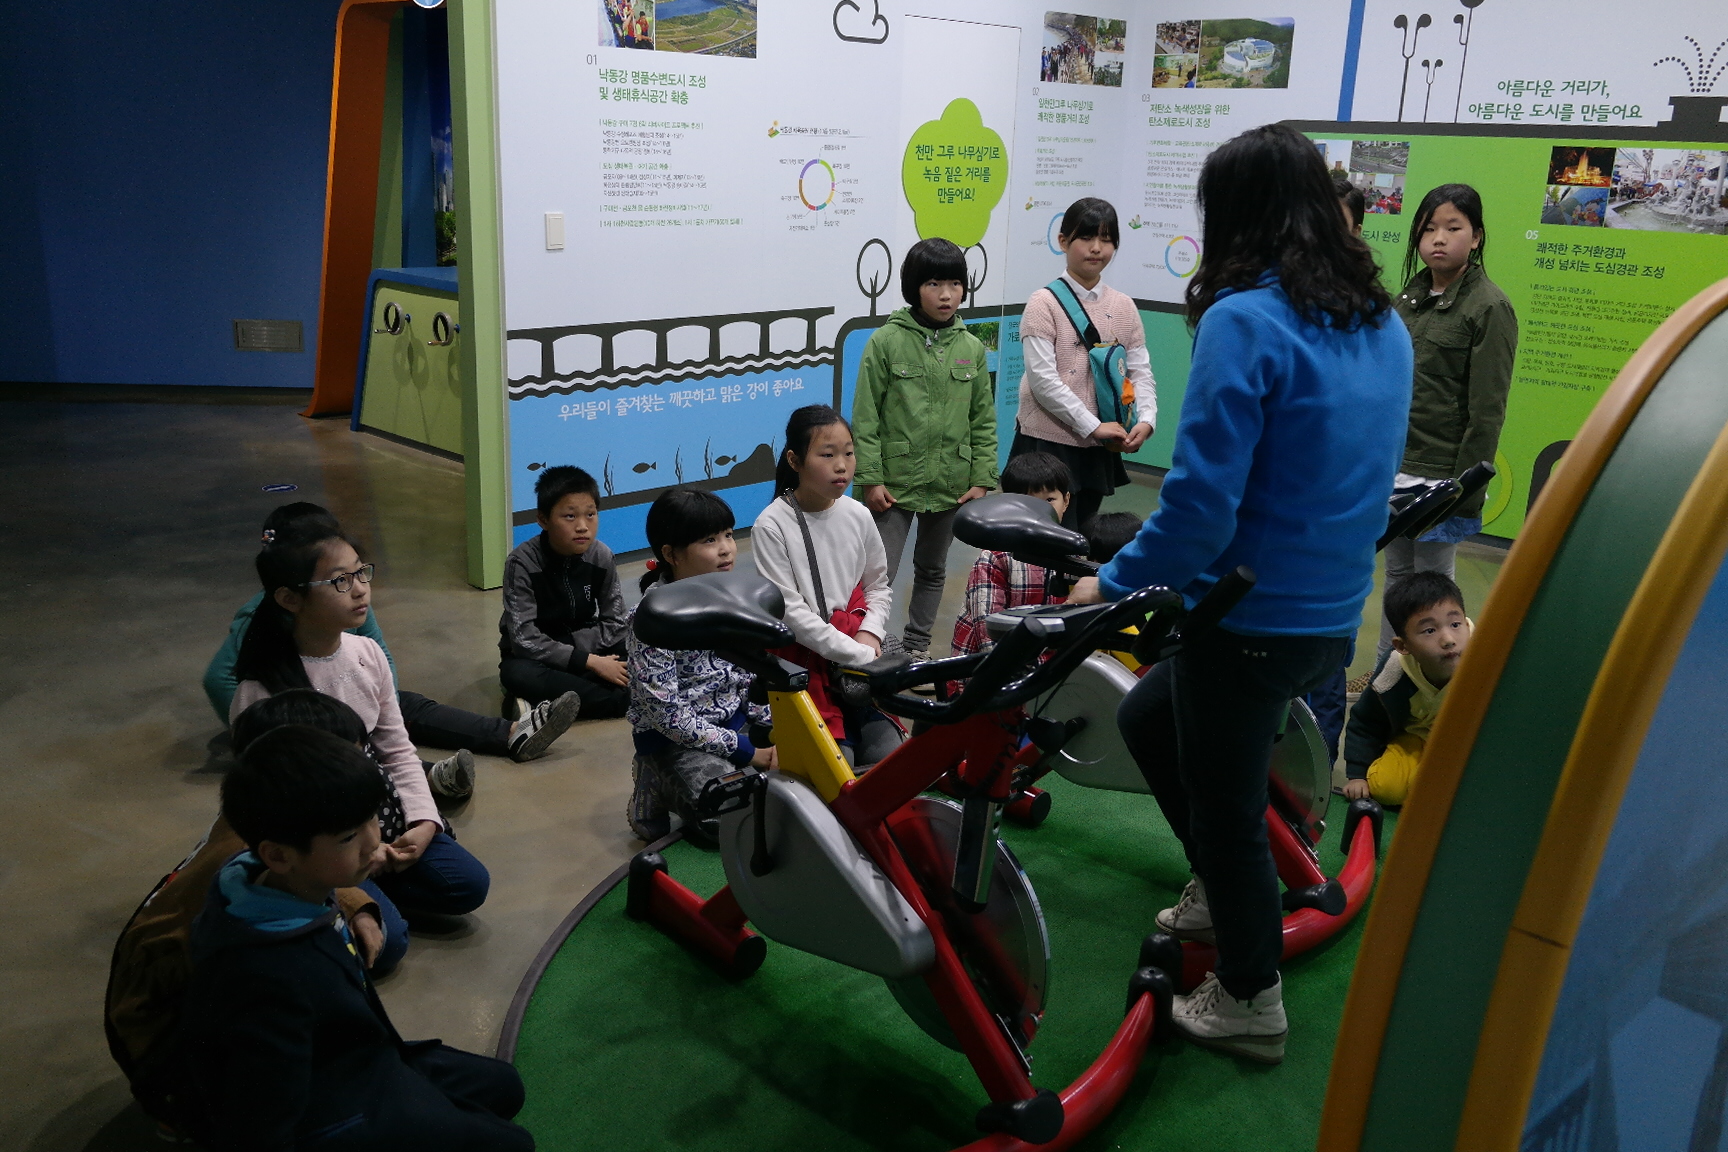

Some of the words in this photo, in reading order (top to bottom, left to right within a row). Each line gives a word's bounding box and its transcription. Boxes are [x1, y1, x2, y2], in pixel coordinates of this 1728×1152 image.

[586, 54, 597, 65] 01
[599, 68, 628, 83] 낙동강
[631, 70, 686, 87] 명품수변도시
[688, 75, 706, 89] 조성
[599, 86, 608, 101] 및
[612, 87, 667, 104] 생태휴식공간
[670, 90, 688, 105] 확충
[1141, 93, 1150, 102] 03
[1497, 79, 1555, 98] 아름다운
[1560, 80, 1610, 99] 거리가,
[1150, 103, 1171, 114] 저탄소
[1174, 103, 1211, 115] 녹색성장을
[1214, 104, 1230, 115] 위한
[1468, 103, 1525, 121] 아름다운
[1529, 103, 1575, 122] 도시를
[1581, 103, 1643, 122] 만들어요
[1079, 113, 1090, 124] 조성
[1148, 116, 1193, 128] 탄소제로도시
[1195, 117, 1211, 128] 조성
[915, 144, 934, 161] 천만
[936, 145, 955, 160] 그루
[958, 145, 1000, 162] 나무심기로
[923, 166, 941, 182] 녹음
[944, 166, 962, 183] 짙은
[965, 166, 991, 183] 거리를
[937, 187, 975, 204] 만들어요!
[1382, 231, 1401, 243] 완성
[1525, 229, 1539, 240] 05
[1536, 242, 1568, 256] 쾌적한
[1571, 244, 1626, 260] 주거환경과
[1534, 257, 1555, 271] 개성
[1558, 259, 1590, 274] 넘치는
[1593, 261, 1638, 277] 도심경관
[1641, 265, 1665, 279] 조성
[557, 399, 611, 422] 우리들이
[614, 393, 666, 416] 즐겨찾는
[668, 388, 717, 408] 깨끗하고
[720, 384, 744, 403] 맑은
[746, 380, 768, 401] 강이
[771, 377, 805, 397] 좋아요
